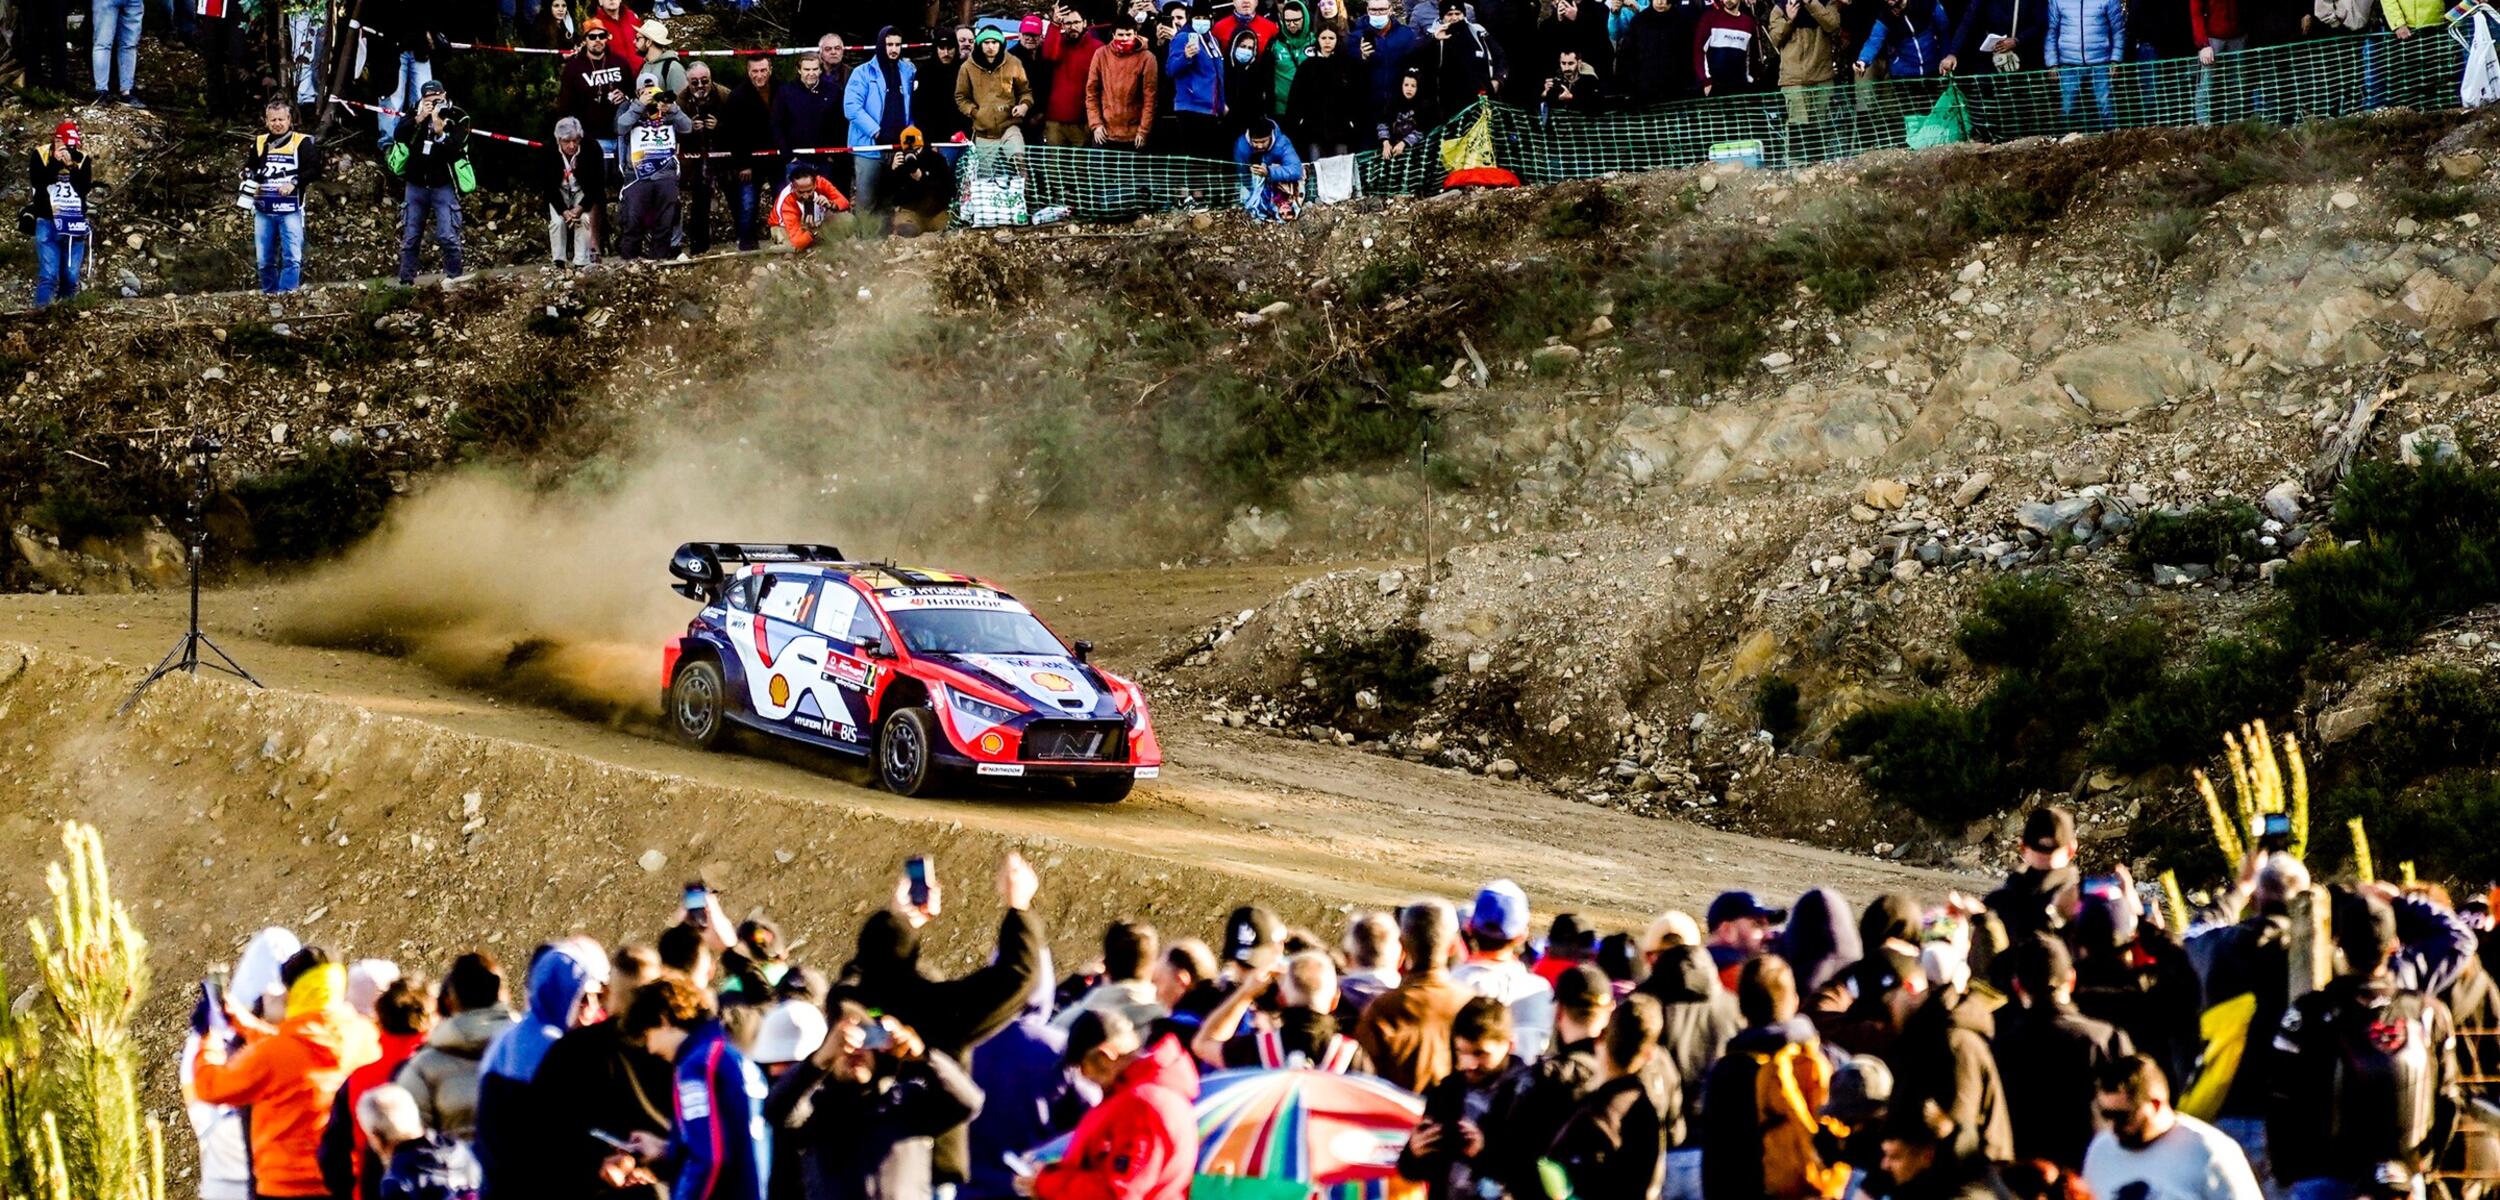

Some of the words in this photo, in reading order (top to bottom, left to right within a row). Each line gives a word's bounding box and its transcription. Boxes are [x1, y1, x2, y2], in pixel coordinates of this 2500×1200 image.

[582, 67, 622, 87] VANS
[641, 128, 670, 142] 233
[916, 586, 972, 597] HYUNDAI
[794, 715, 822, 731] HYUNDAI
